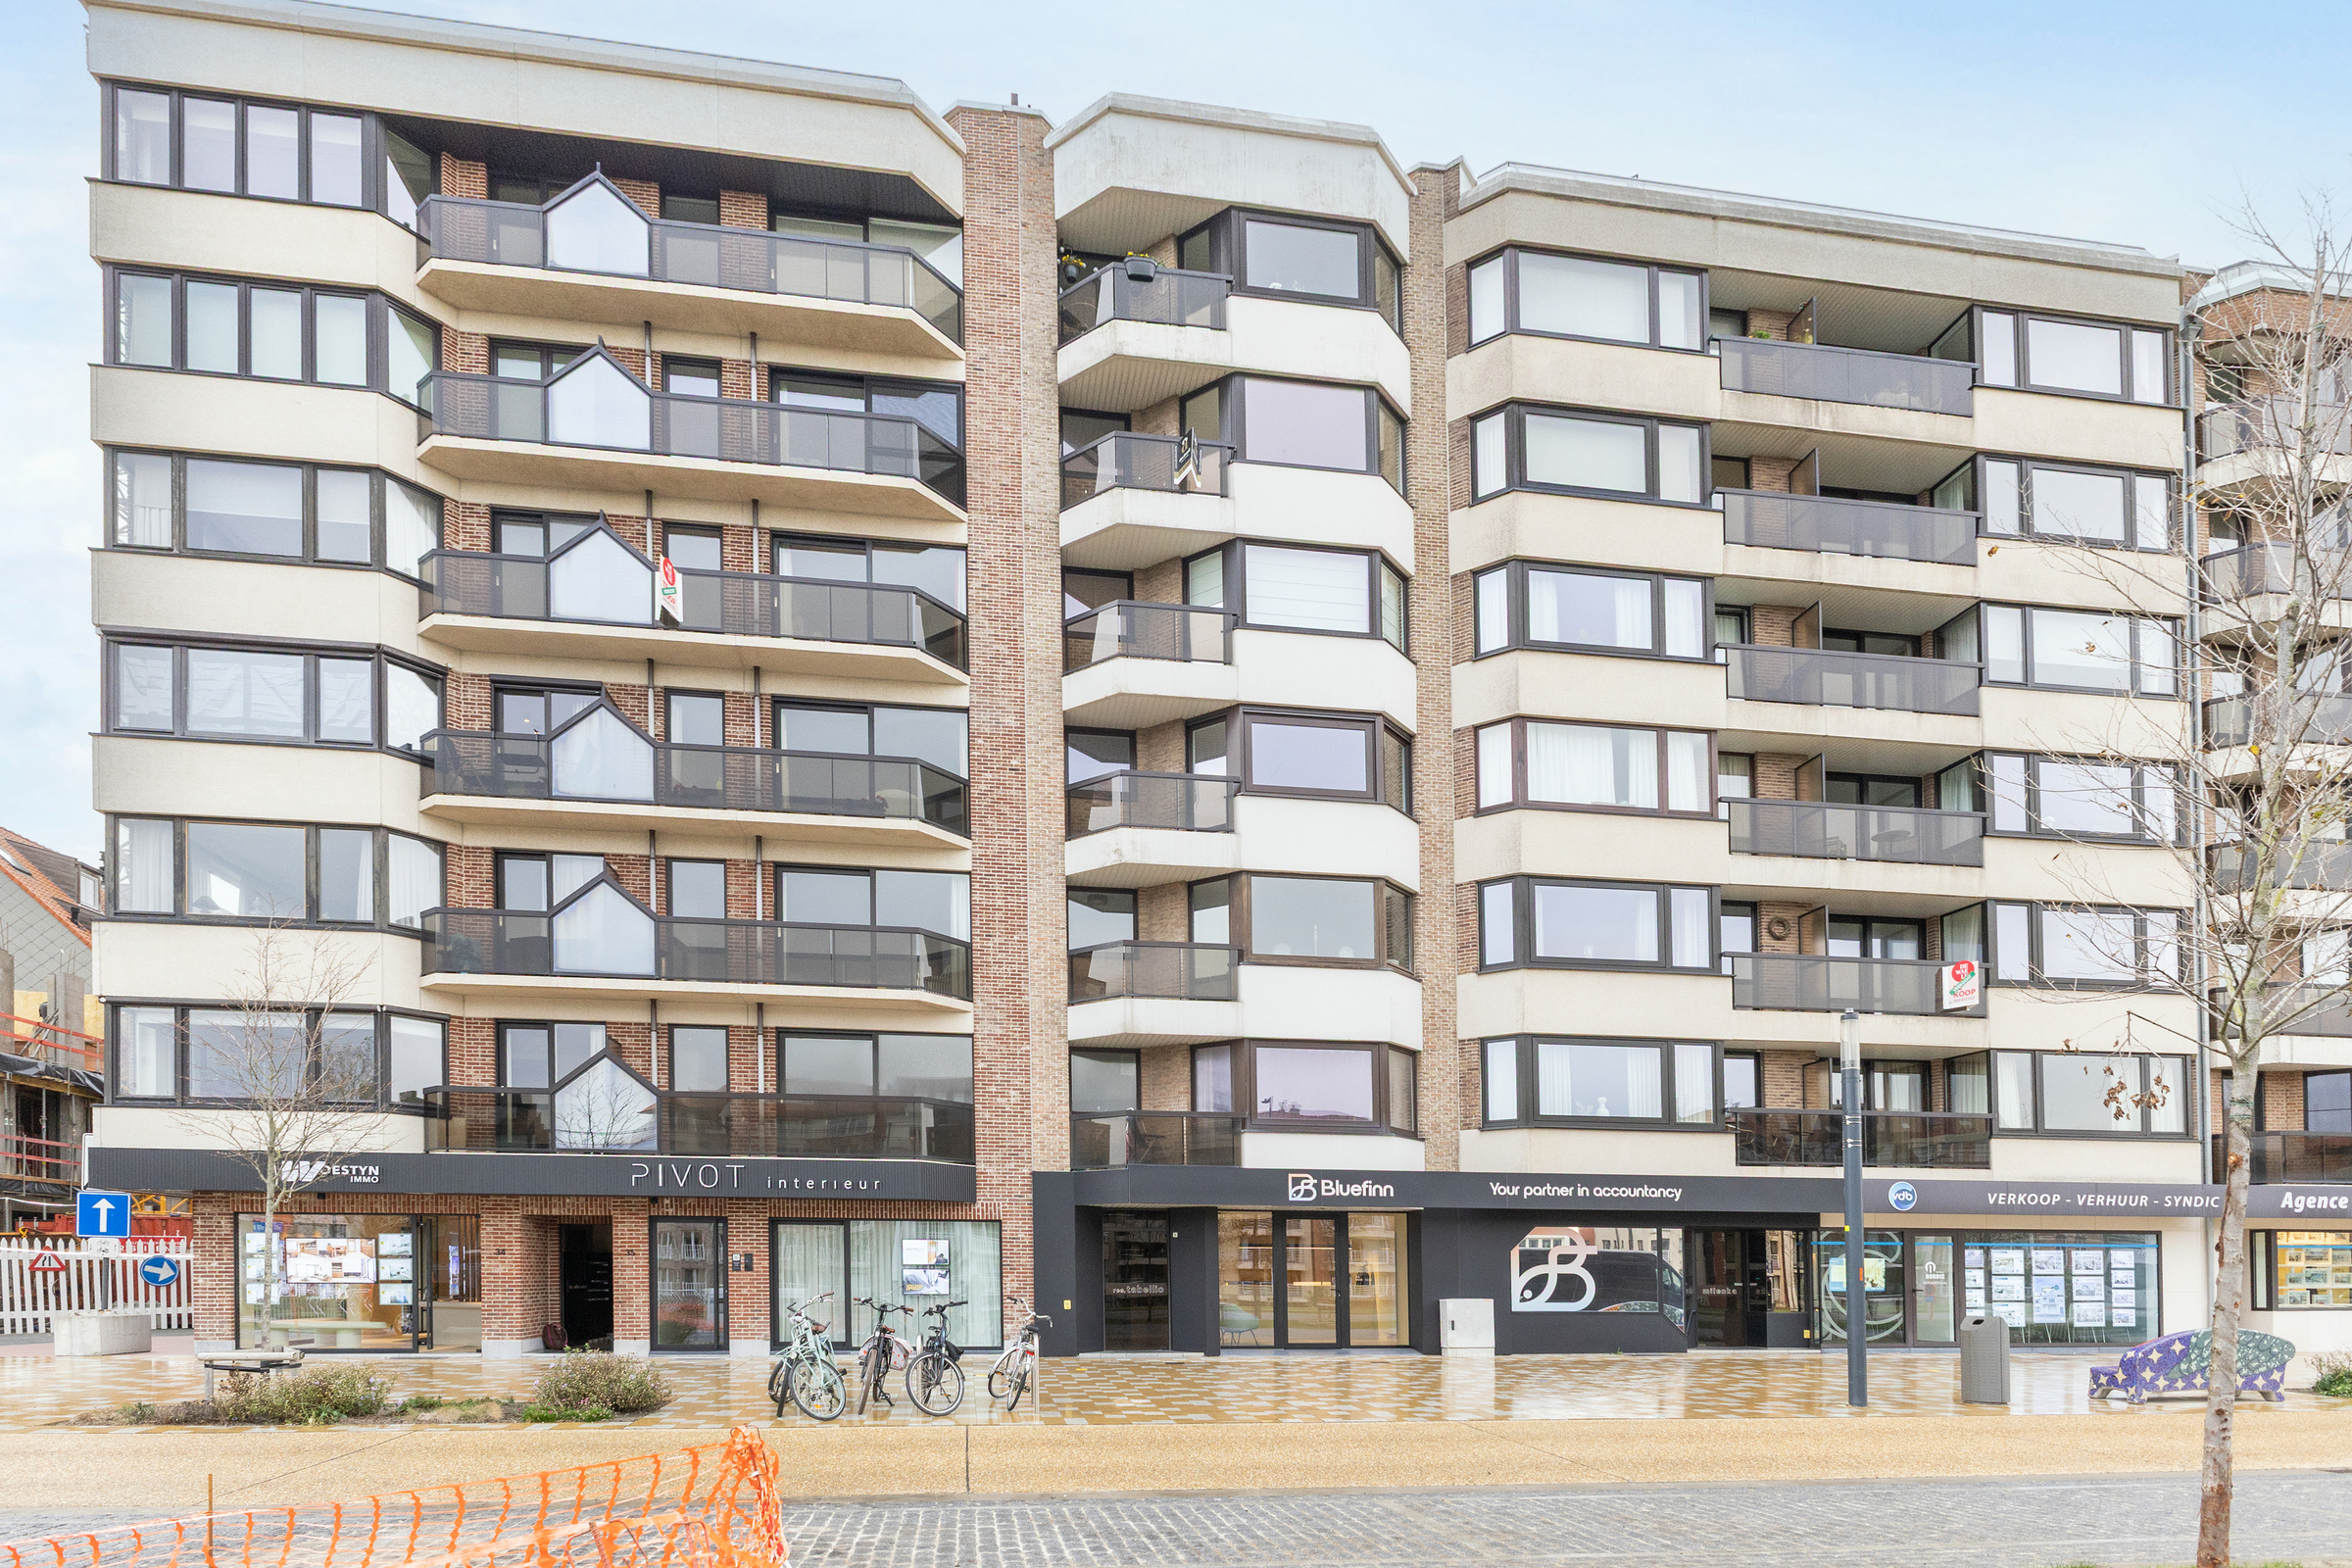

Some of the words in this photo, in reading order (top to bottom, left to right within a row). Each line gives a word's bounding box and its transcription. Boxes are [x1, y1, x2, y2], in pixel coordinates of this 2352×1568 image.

[631, 1163, 746, 1188] PIVOT
[767, 1176, 880, 1190] interieur
[1321, 1179, 1395, 1197] Bluefinn
[1490, 1182, 1520, 1196] Your
[1523, 1183, 1574, 1199] partner
[1577, 1183, 1590, 1197] in
[1592, 1185, 1683, 1201] accountancy
[1892, 1191, 1913, 1201] vdb
[1987, 1193, 2061, 1205] VERKOOP
[2077, 1194, 2149, 1206] VERHUUR
[2164, 1196, 2221, 1208] SYNDIC
[2280, 1191, 2349, 1213] Agence
